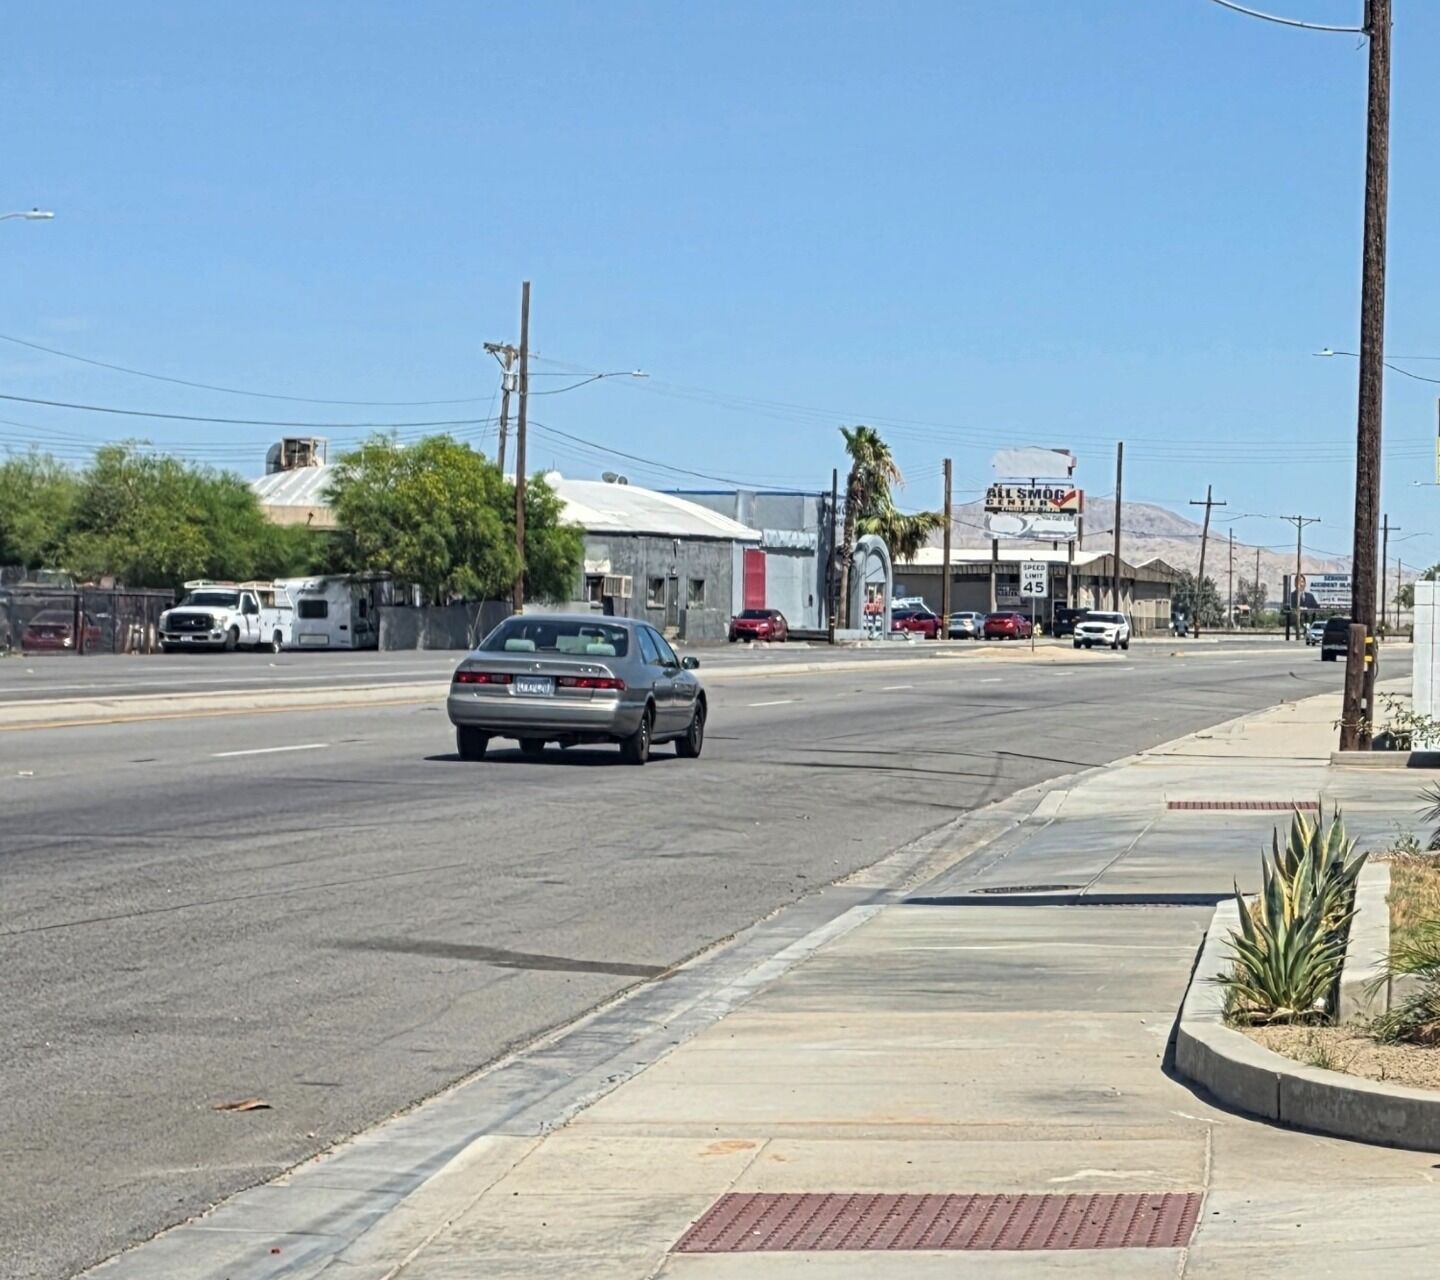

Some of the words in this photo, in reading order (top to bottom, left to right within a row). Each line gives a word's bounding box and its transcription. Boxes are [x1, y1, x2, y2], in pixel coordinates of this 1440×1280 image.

[986, 488, 1012, 498] ALL
[1017, 488, 1064, 499] SMOG
[1023, 582, 1044, 593] 45
